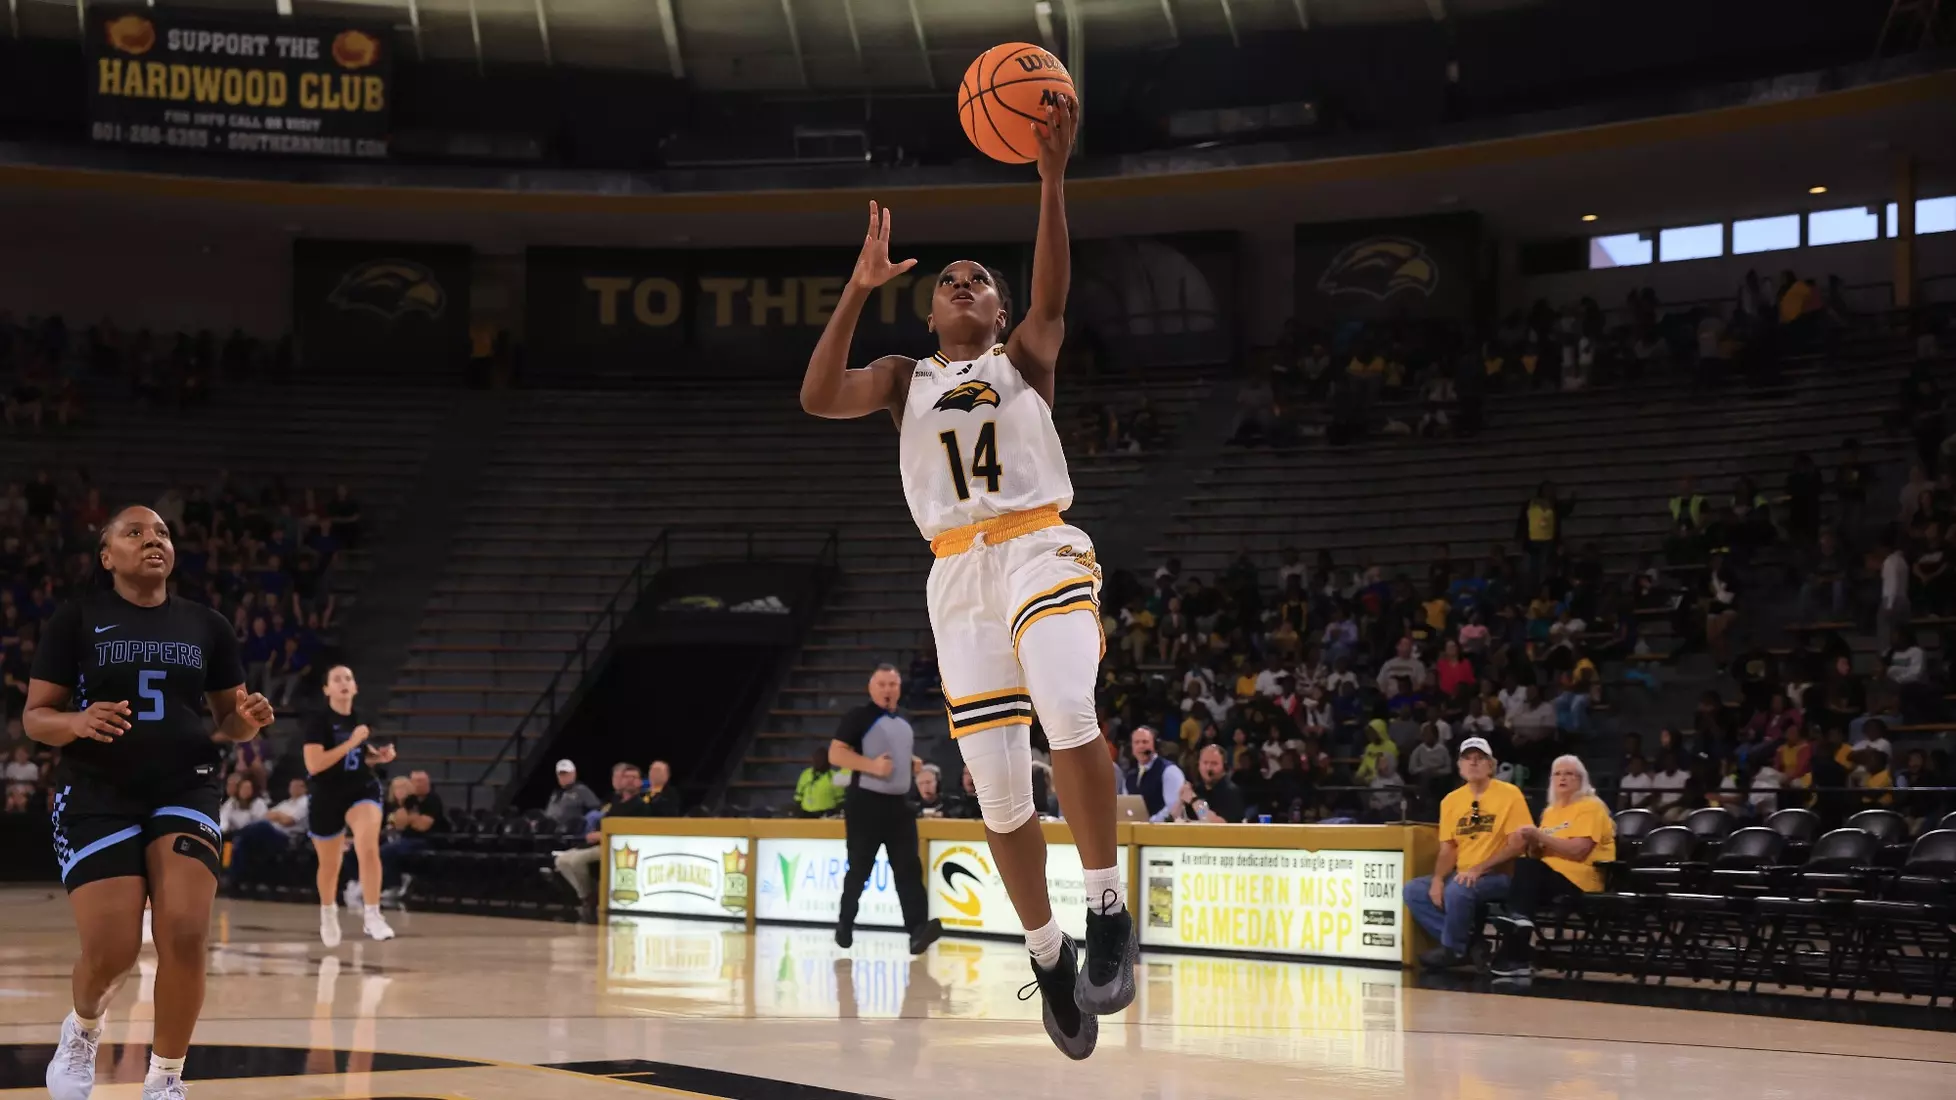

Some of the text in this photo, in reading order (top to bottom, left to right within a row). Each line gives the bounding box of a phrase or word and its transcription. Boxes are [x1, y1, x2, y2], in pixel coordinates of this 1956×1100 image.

[167, 28, 320, 59] SUPPORT THE
[97, 57, 385, 113] HARDWOOD CLUB
[582, 276, 683, 327] TO
[698, 276, 848, 327] THE
[940, 421, 1002, 500] 14
[95, 640, 203, 669] TOPPERS
[137, 669, 168, 721] 5
[1182, 852, 1191, 865] An
[1194, 853, 1217, 866] entire
[1220, 855, 1234, 868] app
[1236, 853, 1278, 868] dedicated
[1281, 856, 1290, 868] to
[1300, 855, 1325, 872] single
[1328, 858, 1353, 872] game
[1363, 863, 1396, 880] GET IT
[1181, 872, 1353, 908] SOUTHERN MISS
[1363, 881, 1396, 899] TODAY
[1180, 904, 1353, 951] GAMEDAY APP
